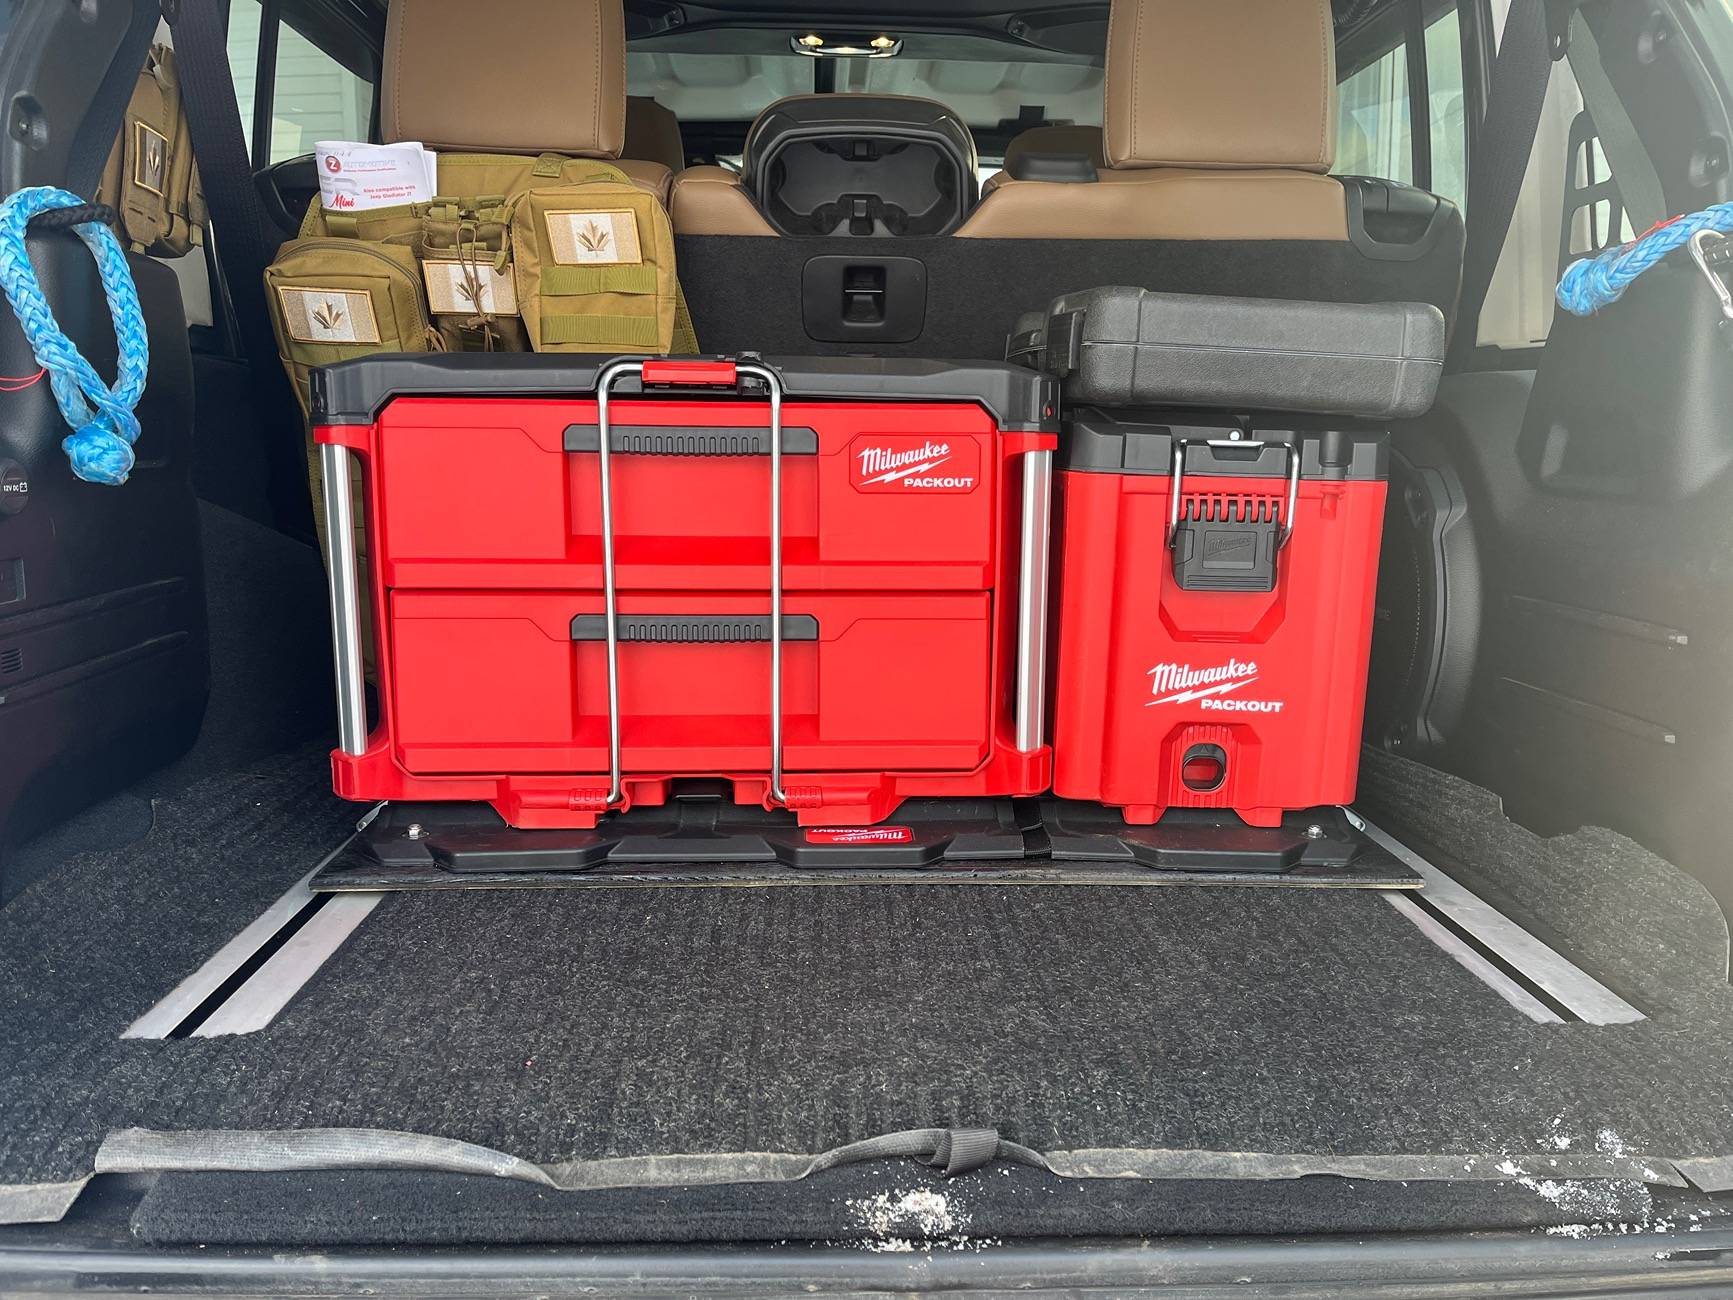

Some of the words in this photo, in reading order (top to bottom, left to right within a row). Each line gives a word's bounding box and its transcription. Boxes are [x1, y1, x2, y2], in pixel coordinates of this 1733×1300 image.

[329, 193, 355, 209] Mini
[856, 441, 951, 476] Milwaukee
[4, 484, 12, 492] 12V
[13, 484, 19, 492] DC
[903, 478, 974, 488] PACKOUT
[1146, 657, 1259, 695] Milwaukee
[1200, 699, 1284, 713] PACKOUT
[832, 830, 907, 842] Milwaukee
